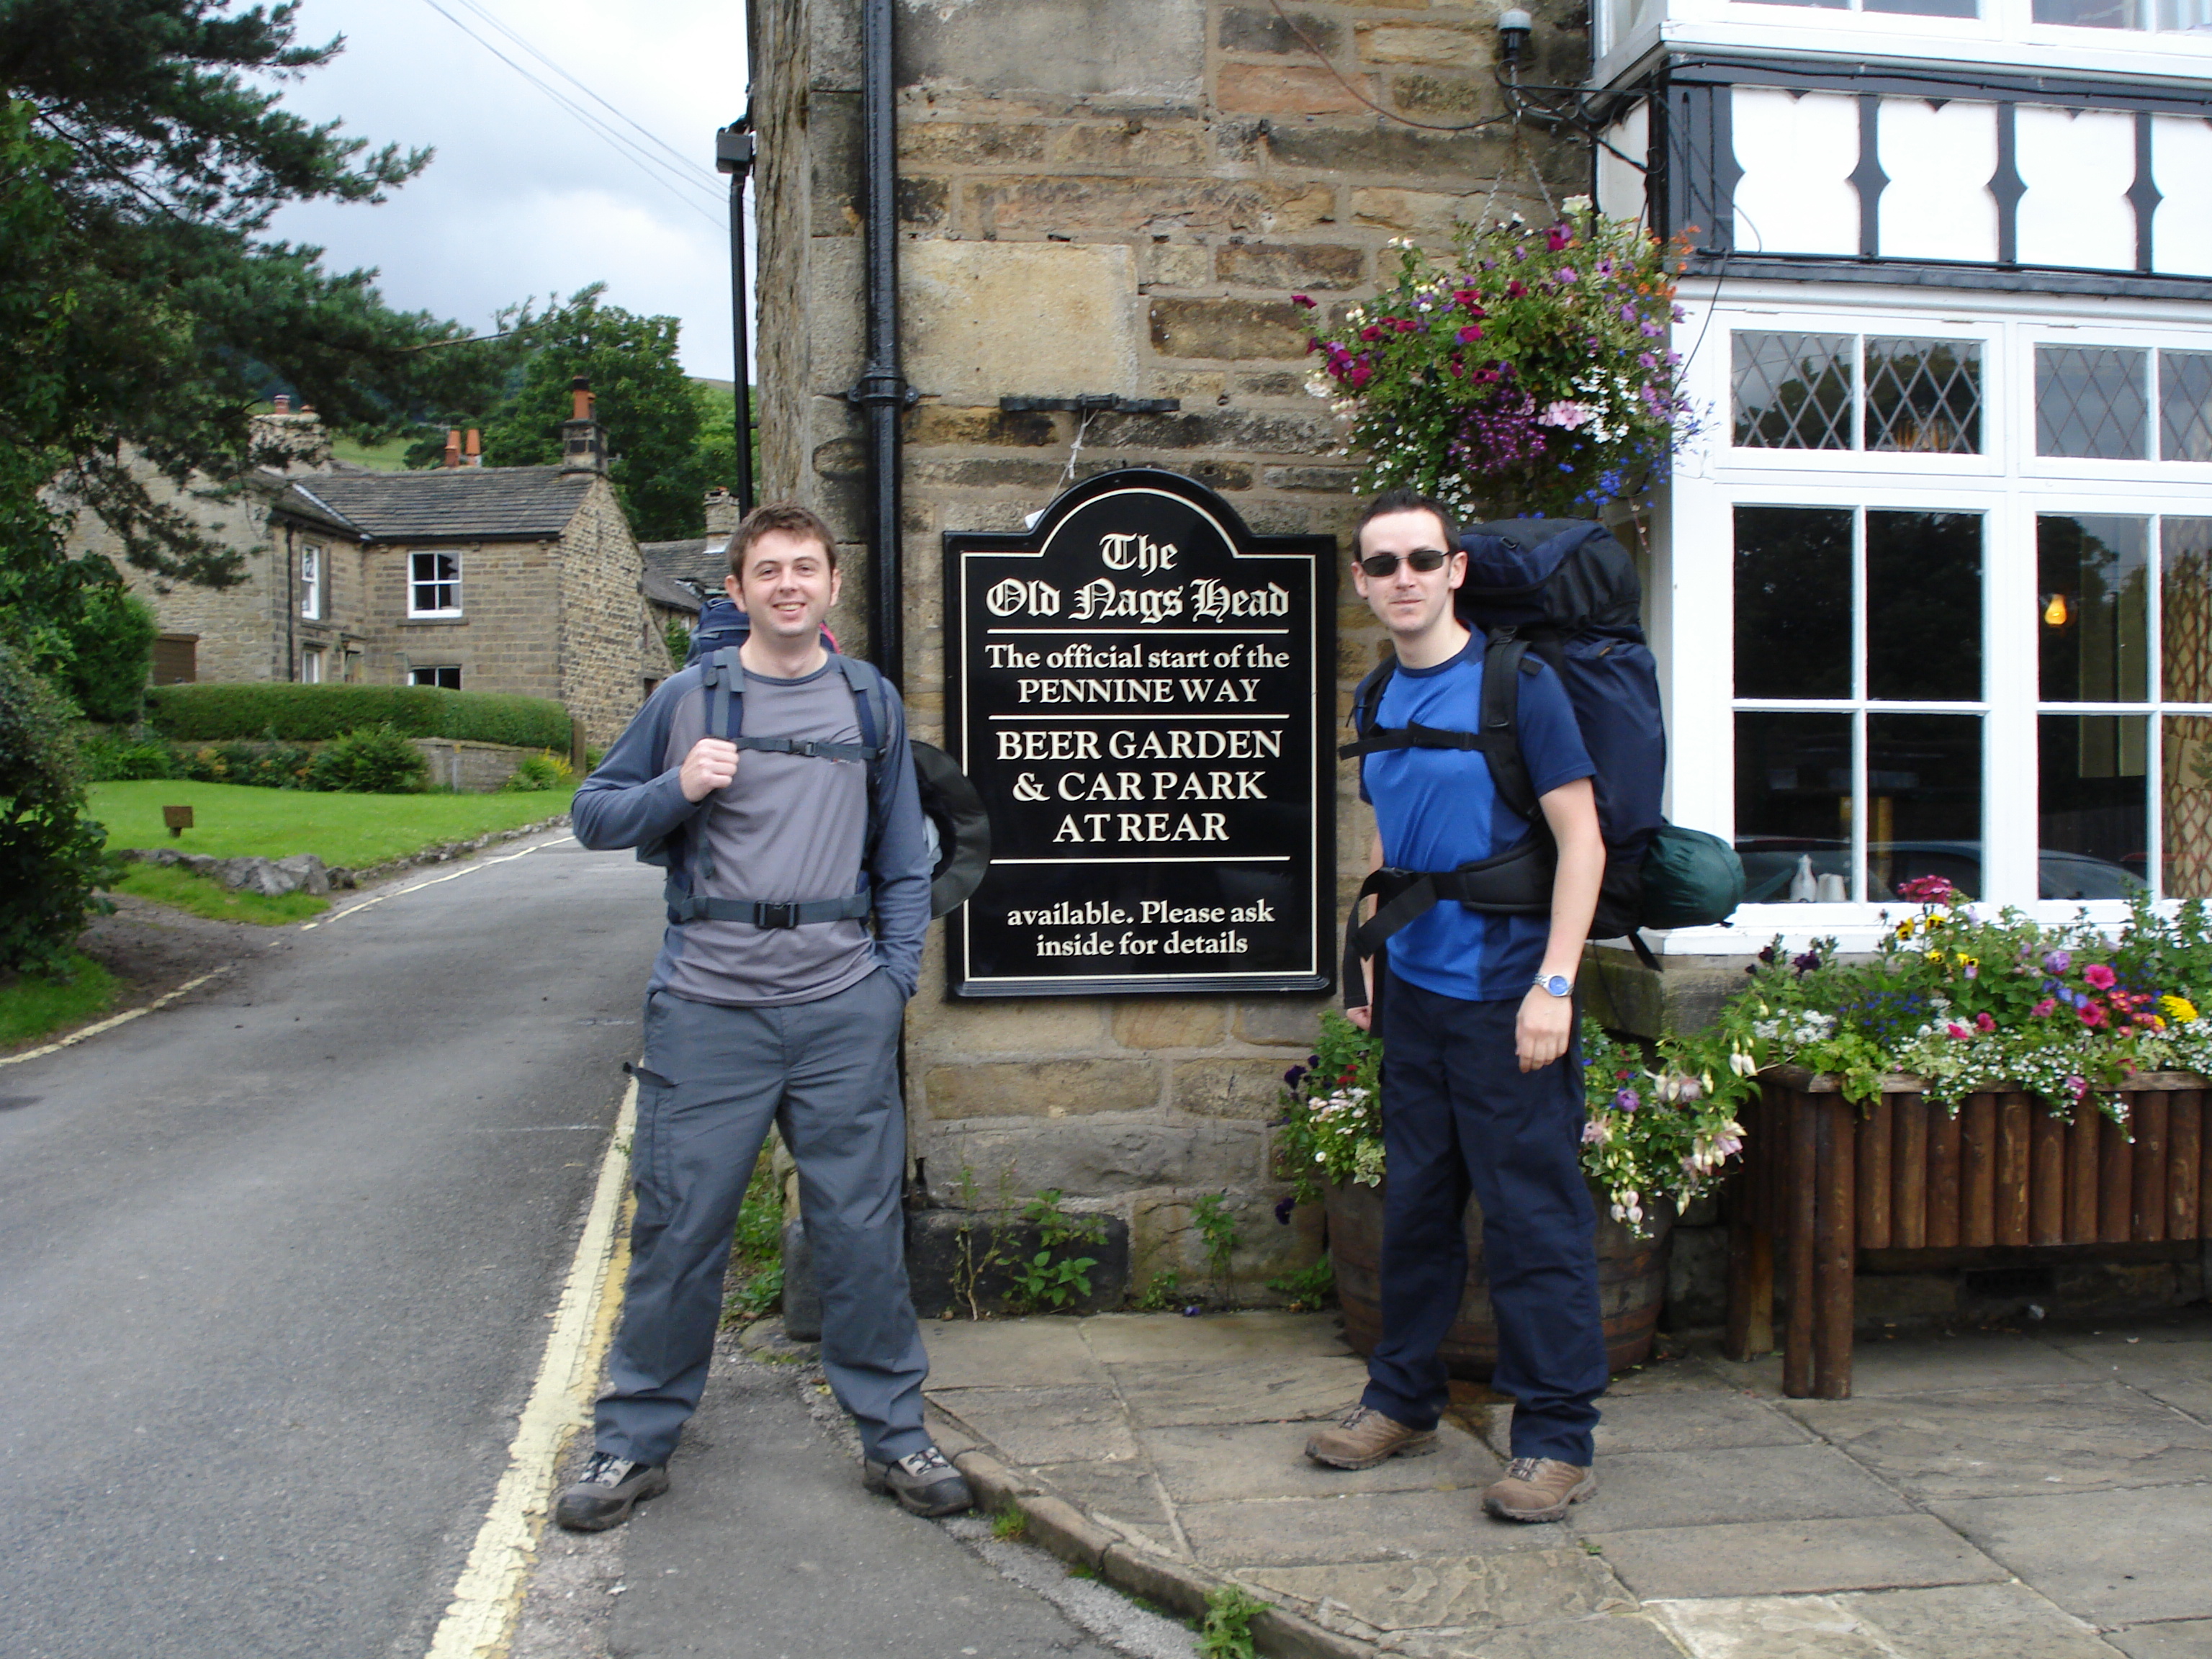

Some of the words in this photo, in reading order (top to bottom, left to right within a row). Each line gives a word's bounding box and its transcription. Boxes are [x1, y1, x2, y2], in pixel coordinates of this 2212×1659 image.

[1098, 532, 1178, 577] The
[986, 577, 1061, 617] Old
[1067, 577, 1184, 624] Nags
[1190, 578, 1290, 624] Head
[984, 643, 1041, 669] The
[1046, 643, 1143, 669] official
[1148, 649, 1210, 668] start
[1213, 643, 1245, 668] of
[1246, 643, 1290, 668] the
[1017, 678, 1174, 703] PENNINE
[1178, 678, 1261, 703] WAY
[995, 730, 1102, 760] BEER
[1108, 729, 1283, 760] GARDEN
[1012, 772, 1051, 801] &
[1058, 772, 1146, 801] CAR
[1151, 770, 1268, 801] PARK
[1052, 813, 1111, 842] AT
[1116, 812, 1230, 842] REAR
[1007, 900, 1135, 926] available.
[1139, 899, 1226, 924] Please
[1230, 898, 1276, 922] ask
[1036, 931, 1115, 956] inside
[1118, 931, 1159, 956] for
[1163, 930, 1249, 954] details
